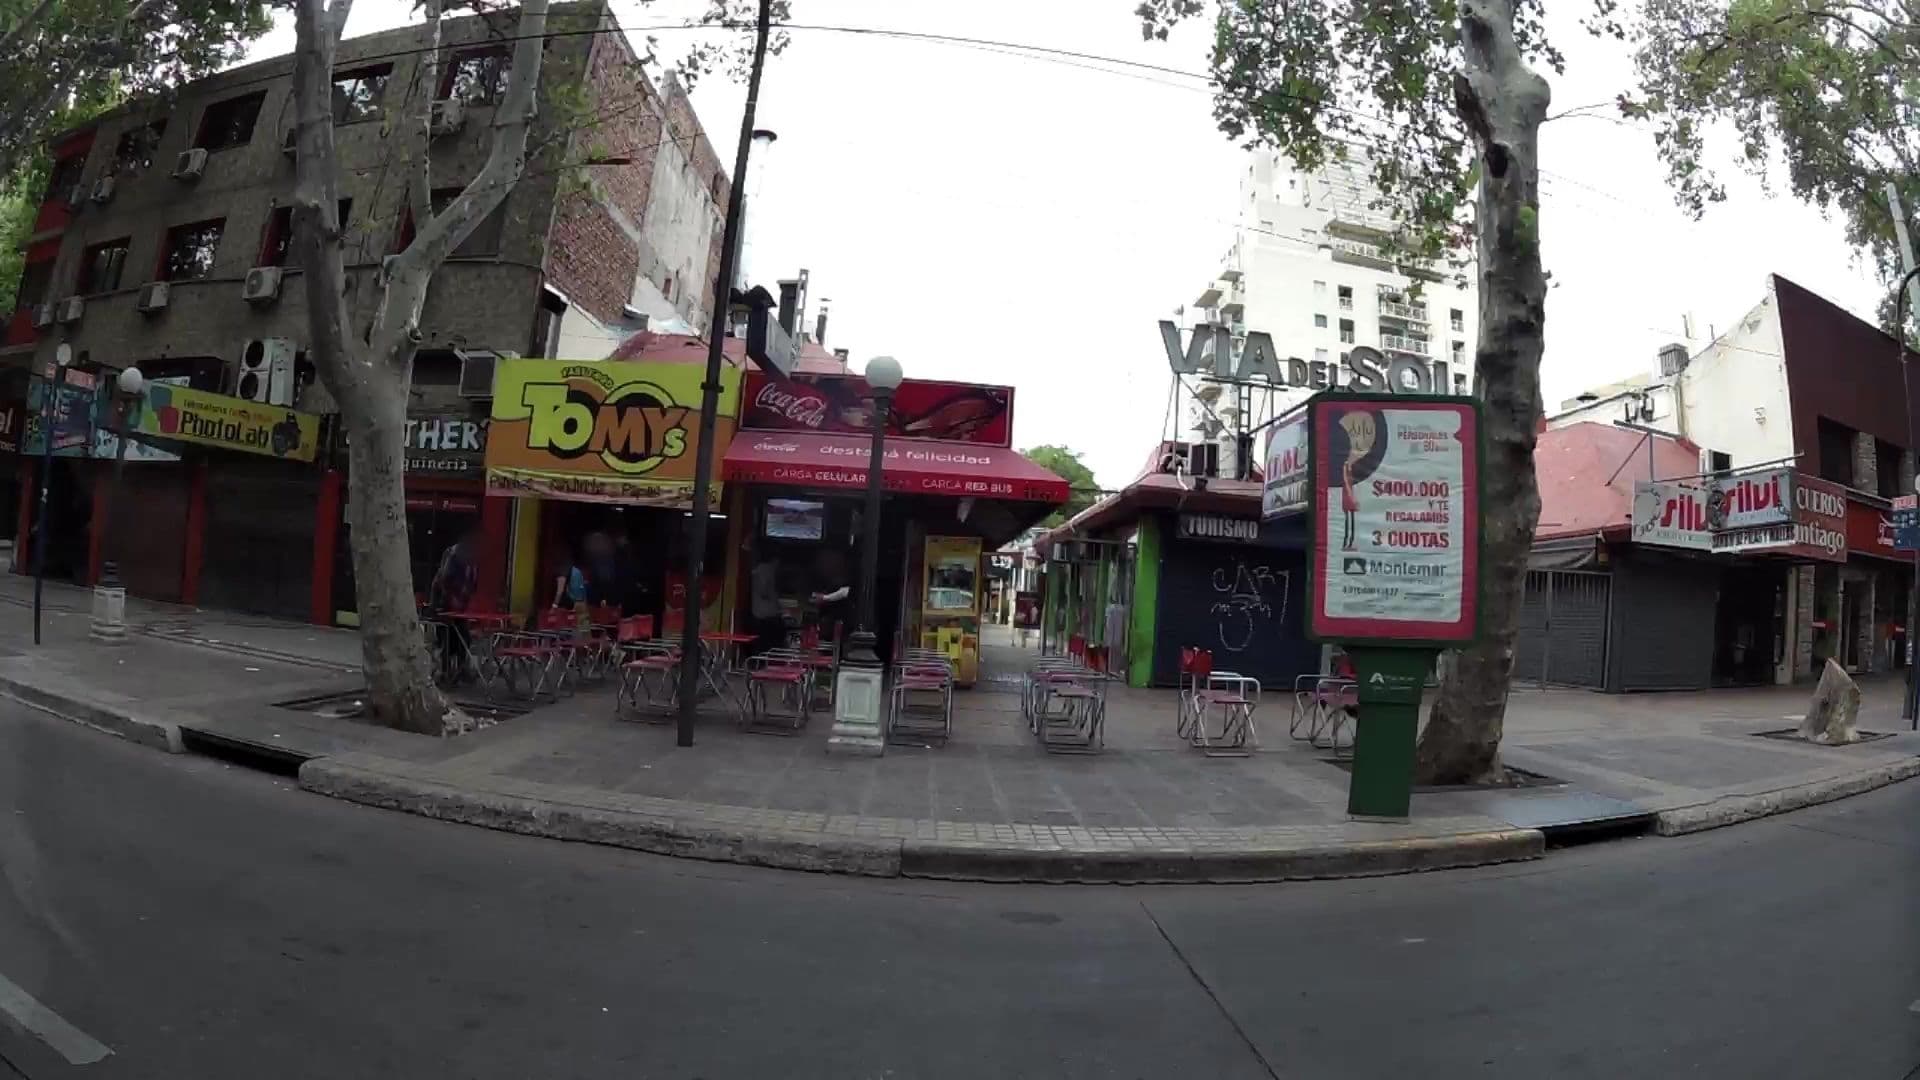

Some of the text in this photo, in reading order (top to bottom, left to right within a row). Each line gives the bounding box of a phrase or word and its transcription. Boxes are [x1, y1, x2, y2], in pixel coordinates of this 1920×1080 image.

[1159, 320, 1284, 385] VIA
[1288, 357, 1347, 391] DEL
[179, 410, 269, 449] PhotoLab
[403, 419, 490, 450] THER'
[401, 454, 468, 472] quineria
[820, 445, 991, 465] destaá felicidad
[815, 471, 866, 483] CELULAR
[990, 483, 1013, 494] BUS
[1371, 480, 1450, 499] $400.000
[1796, 486, 1845, 519] CUEROS
[1187, 516, 1259, 539] TURISMO
[1371, 530, 1450, 549] 3 CUOTAS
